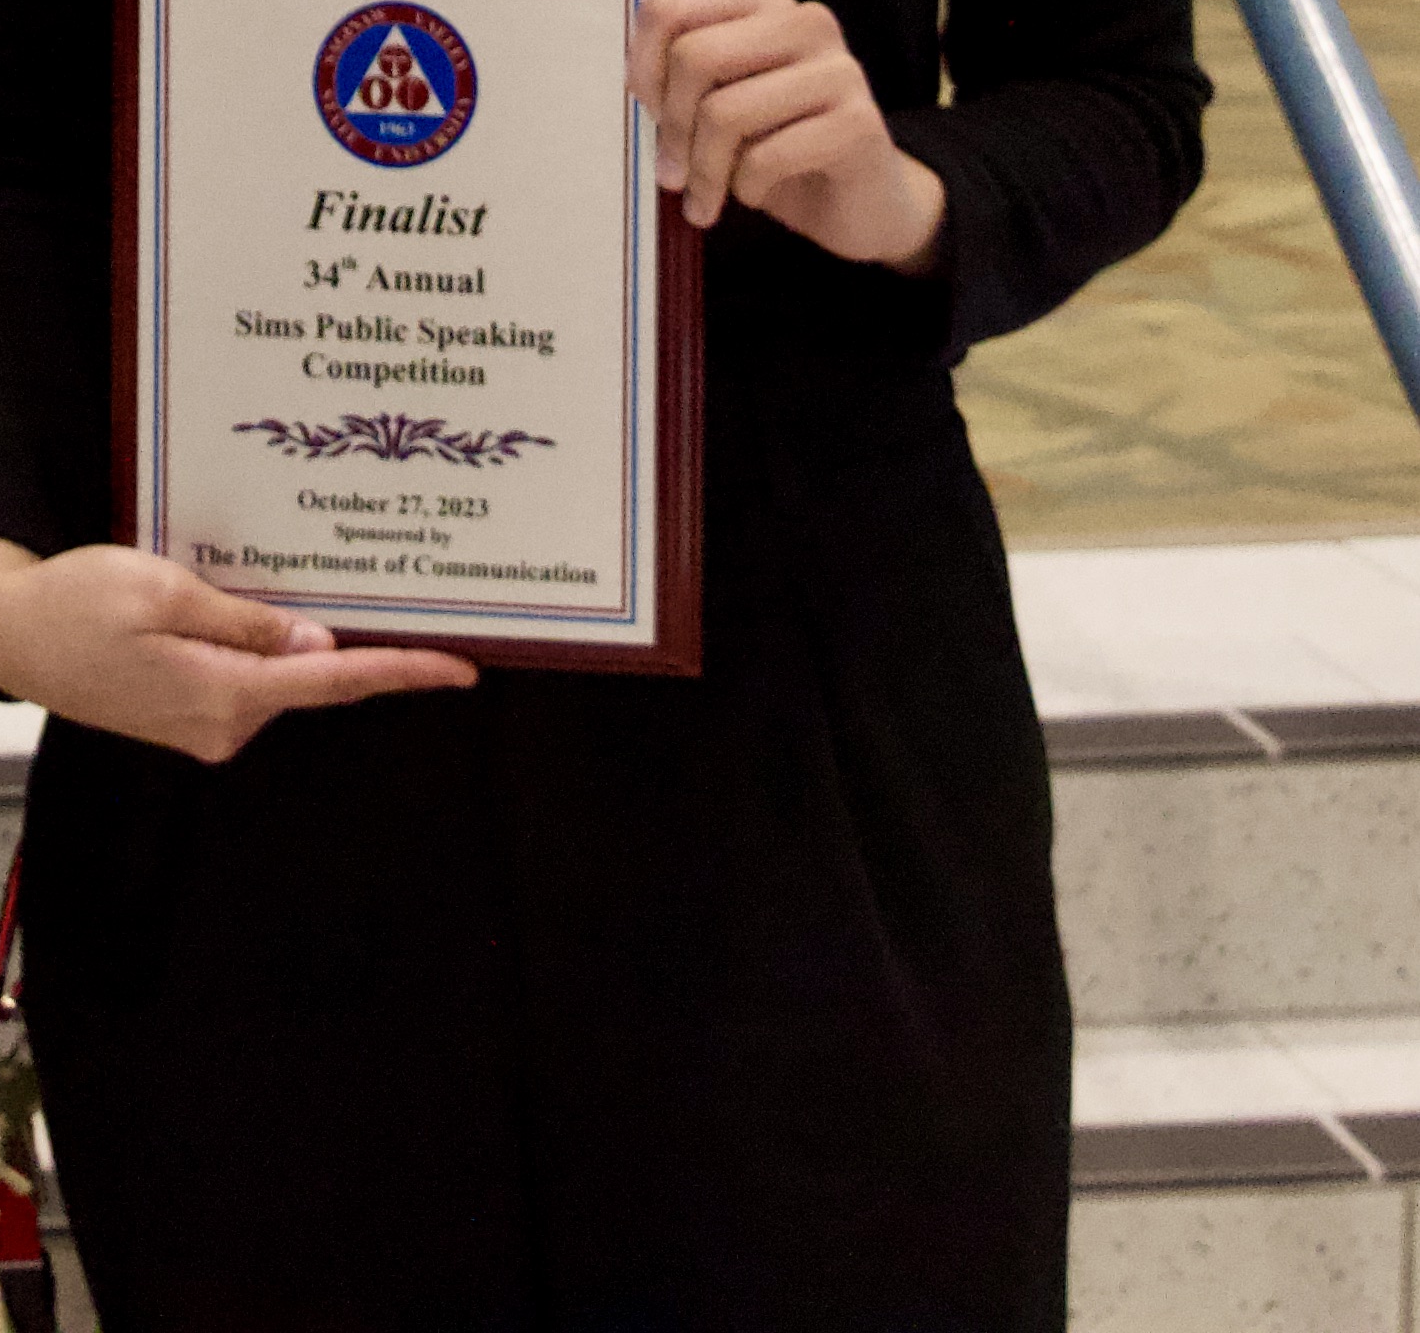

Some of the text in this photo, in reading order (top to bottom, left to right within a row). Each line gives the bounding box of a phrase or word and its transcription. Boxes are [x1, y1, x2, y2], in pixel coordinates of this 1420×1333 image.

[307, 190, 487, 237] Finalist
[304, 257, 485, 295] 34th Annual
[235, 311, 555, 356] Sims Public Speaking
[301, 352, 486, 389] Competition
[296, 489, 489, 519] October 27, 2023
[334, 523, 452, 549] Sponsored by
[191, 542, 597, 585] The Department of Communication
